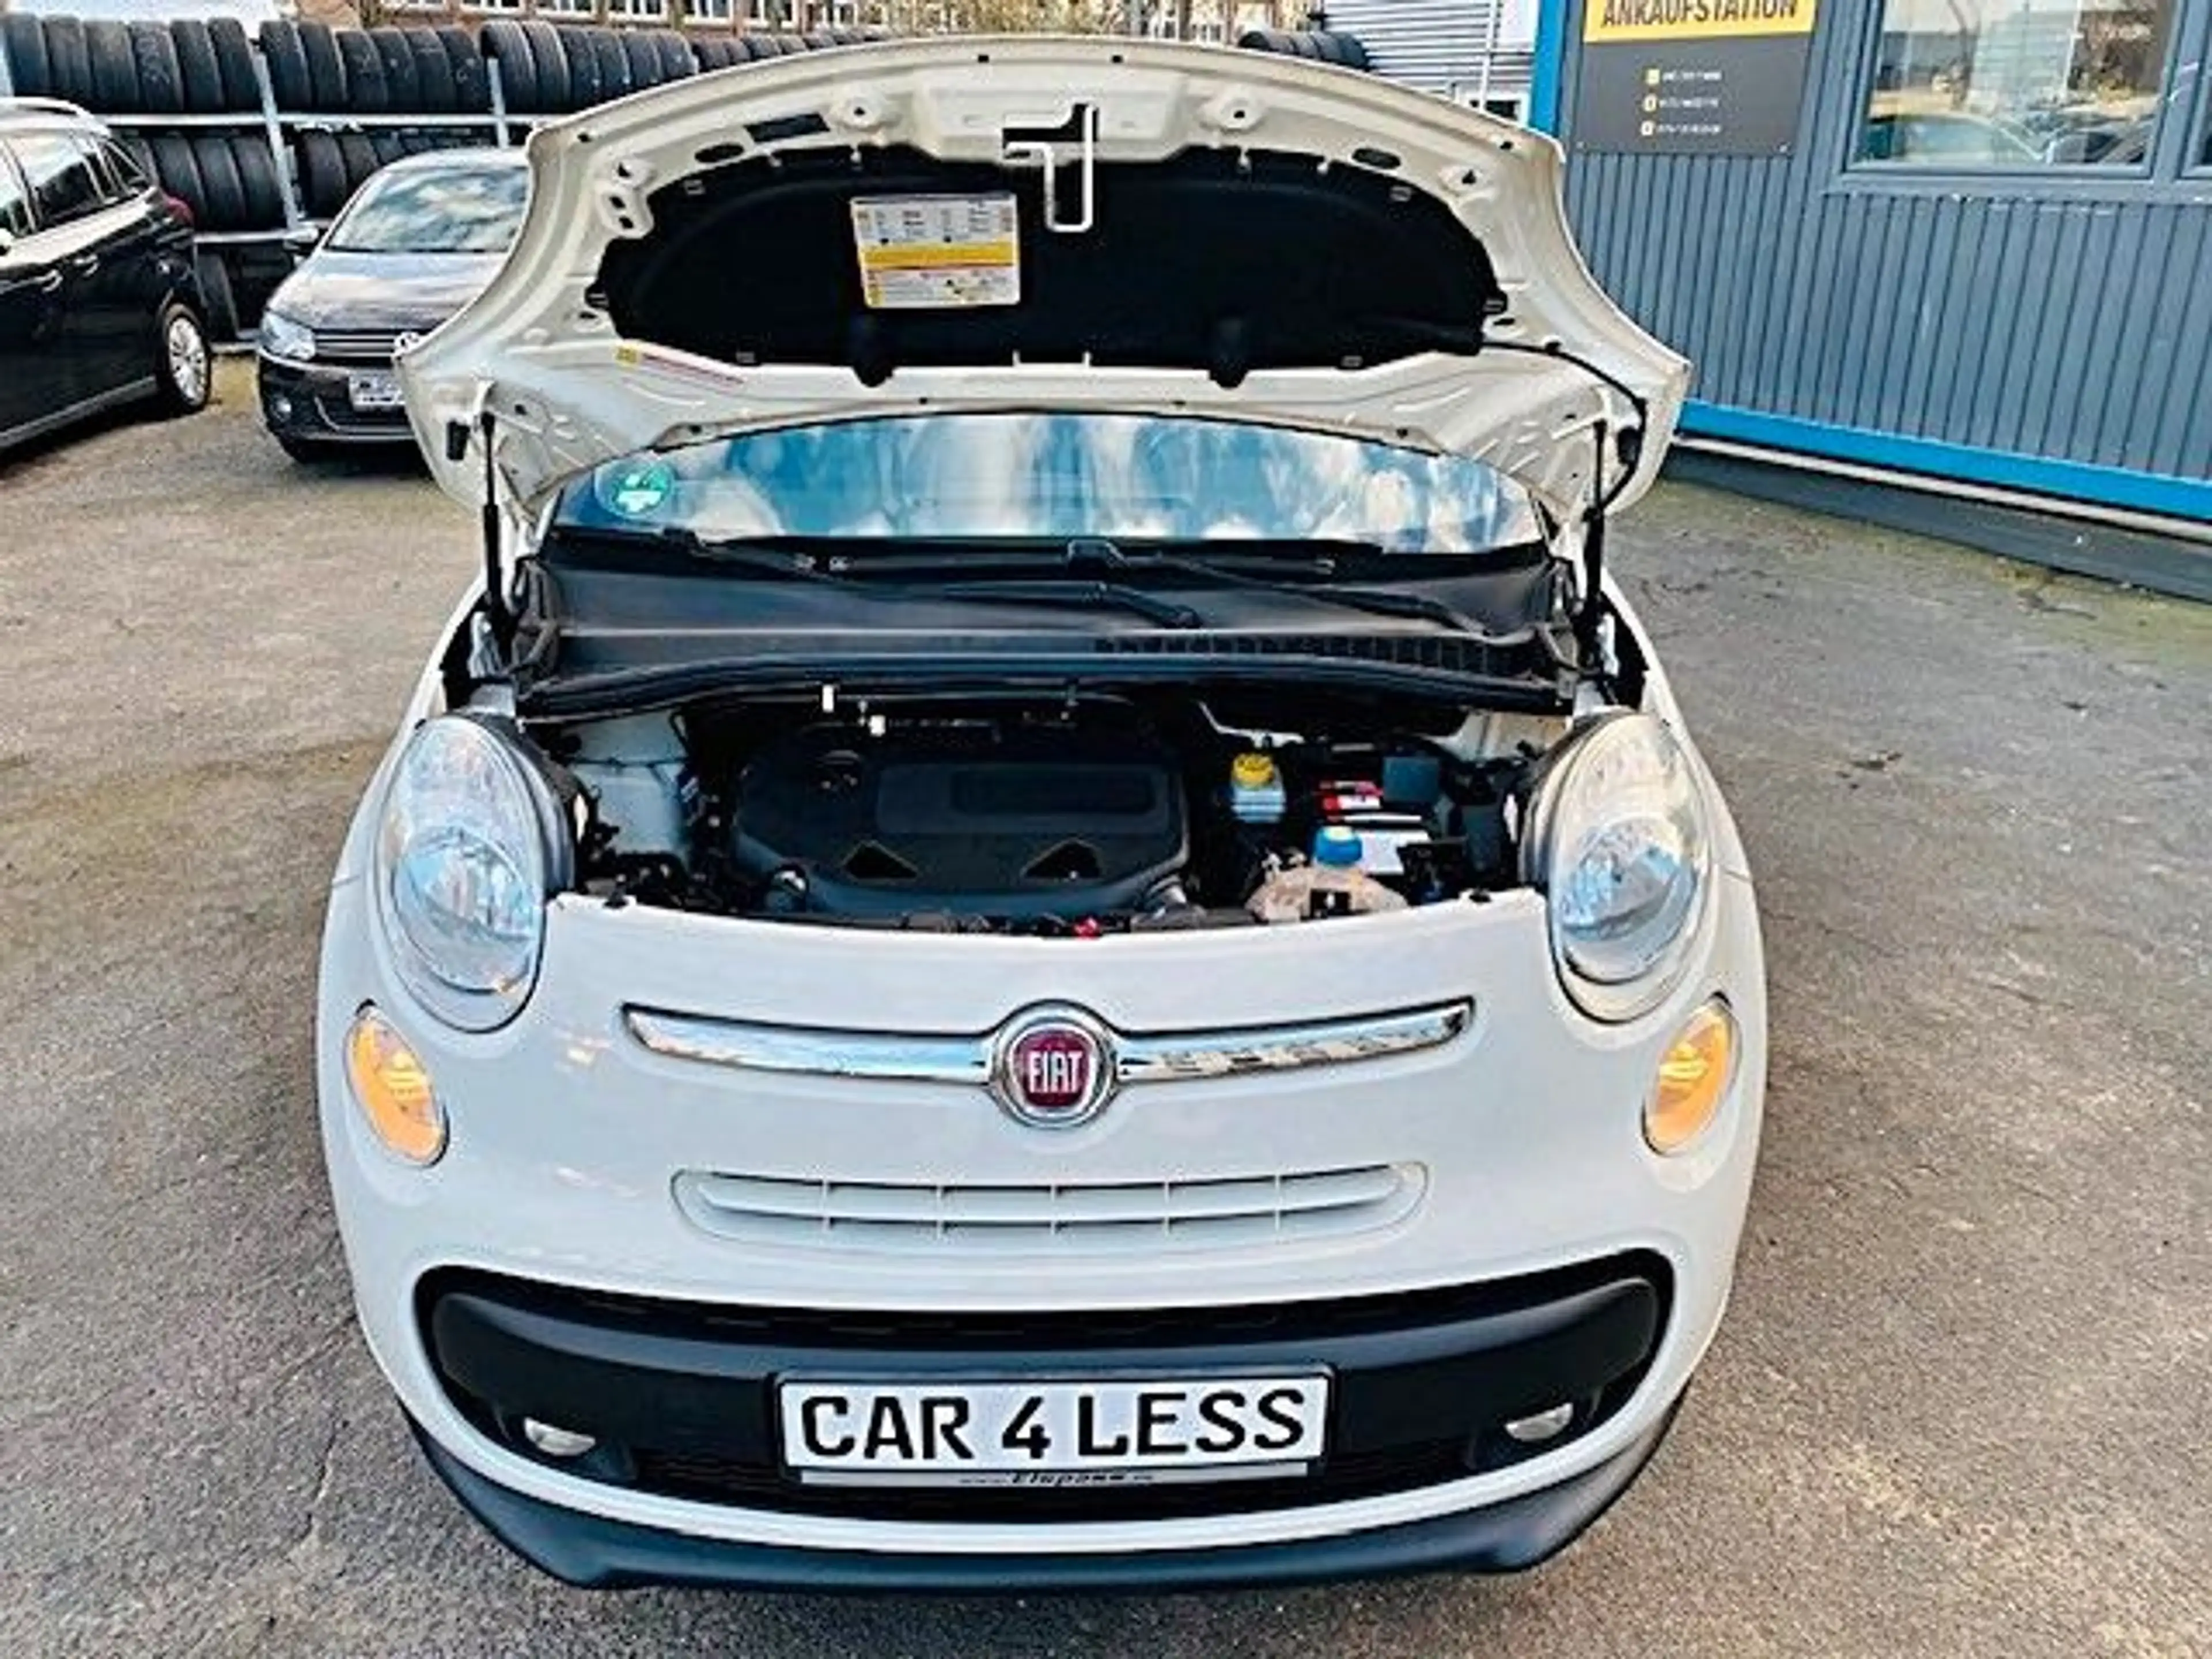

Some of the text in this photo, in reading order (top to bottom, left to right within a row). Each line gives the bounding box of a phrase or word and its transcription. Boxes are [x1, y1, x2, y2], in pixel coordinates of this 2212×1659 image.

[1600, 0, 1797, 28] ANKAUFSTATION
[1029, 1050, 1083, 1093] FIAT
[801, 1389, 1305, 1459] CAR 4 LESS
